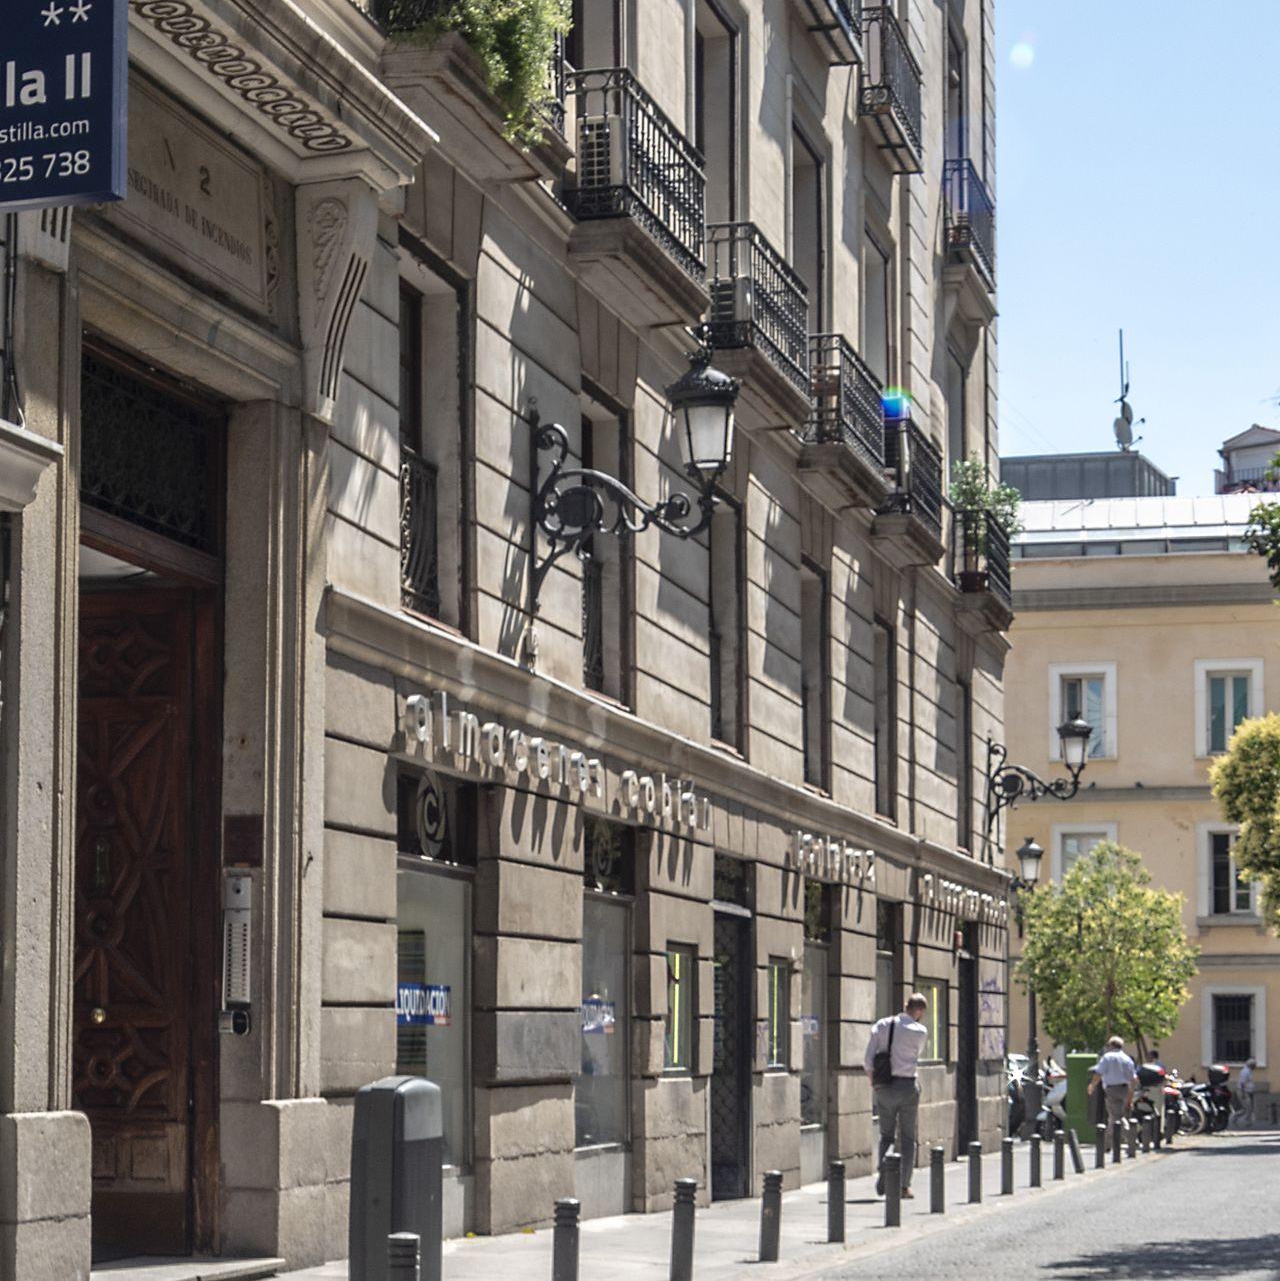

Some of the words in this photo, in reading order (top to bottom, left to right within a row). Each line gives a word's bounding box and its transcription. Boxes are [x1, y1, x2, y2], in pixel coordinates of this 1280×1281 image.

[64, 51, 92, 101] II
[42, 149, 91, 178] 738
[406, 690, 601, 800] almacenes
